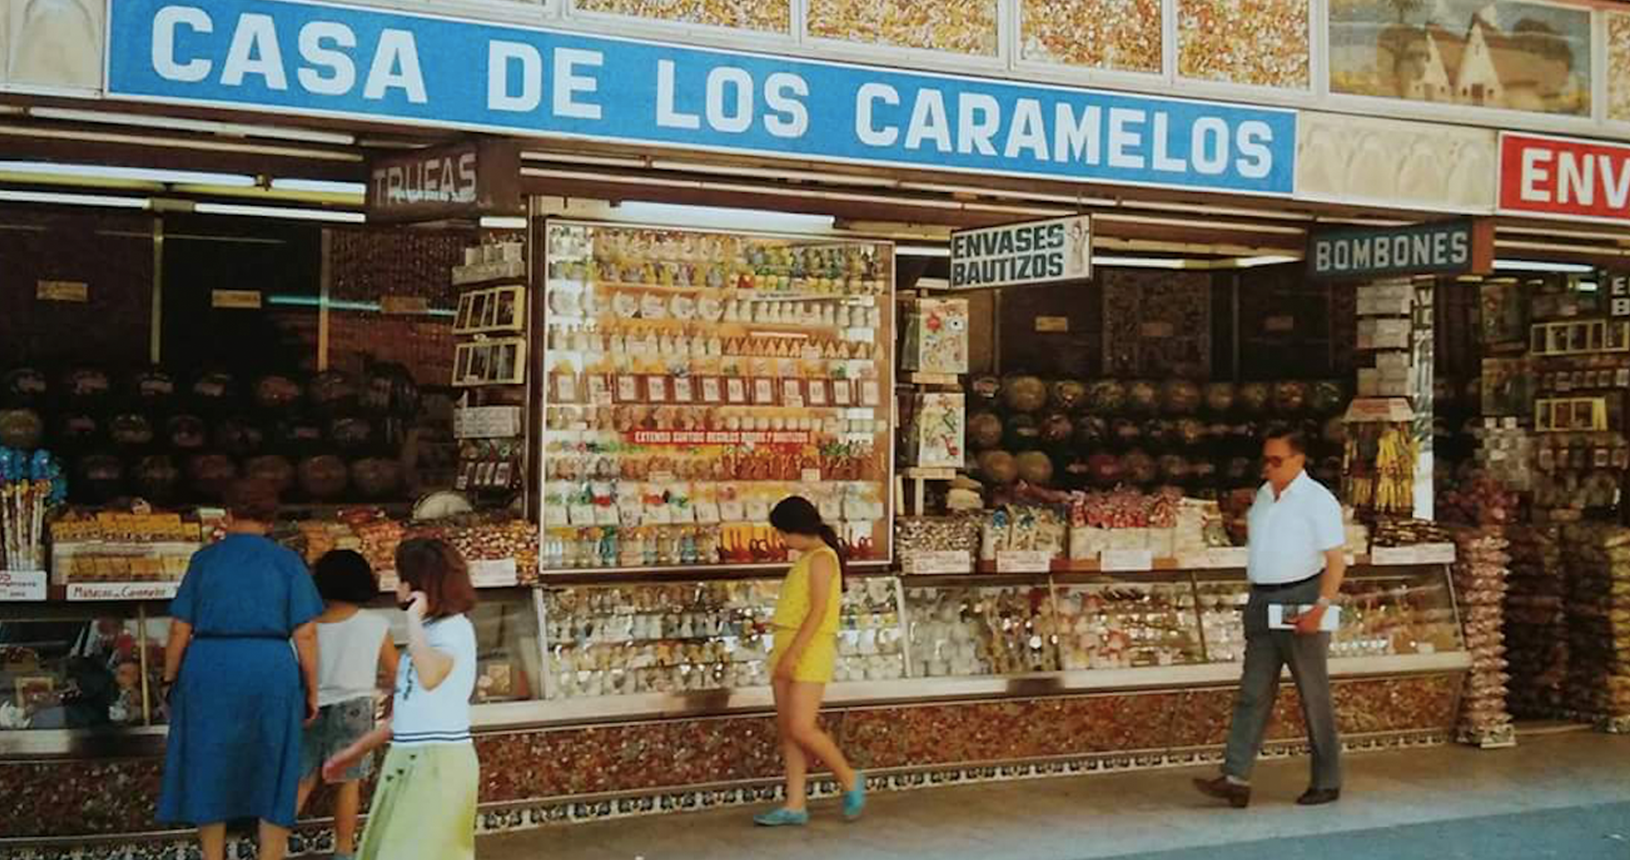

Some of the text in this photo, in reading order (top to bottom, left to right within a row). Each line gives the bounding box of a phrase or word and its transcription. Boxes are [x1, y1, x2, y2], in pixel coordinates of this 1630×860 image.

[152, 5, 1272, 179] CASA DE LOS CARAMELOS
[1520, 147, 1630, 209] ENV
[953, 222, 1064, 259] ENVASES
[1316, 231, 1468, 272] BOMBONES
[952, 253, 1063, 286] BAUTIZOS
